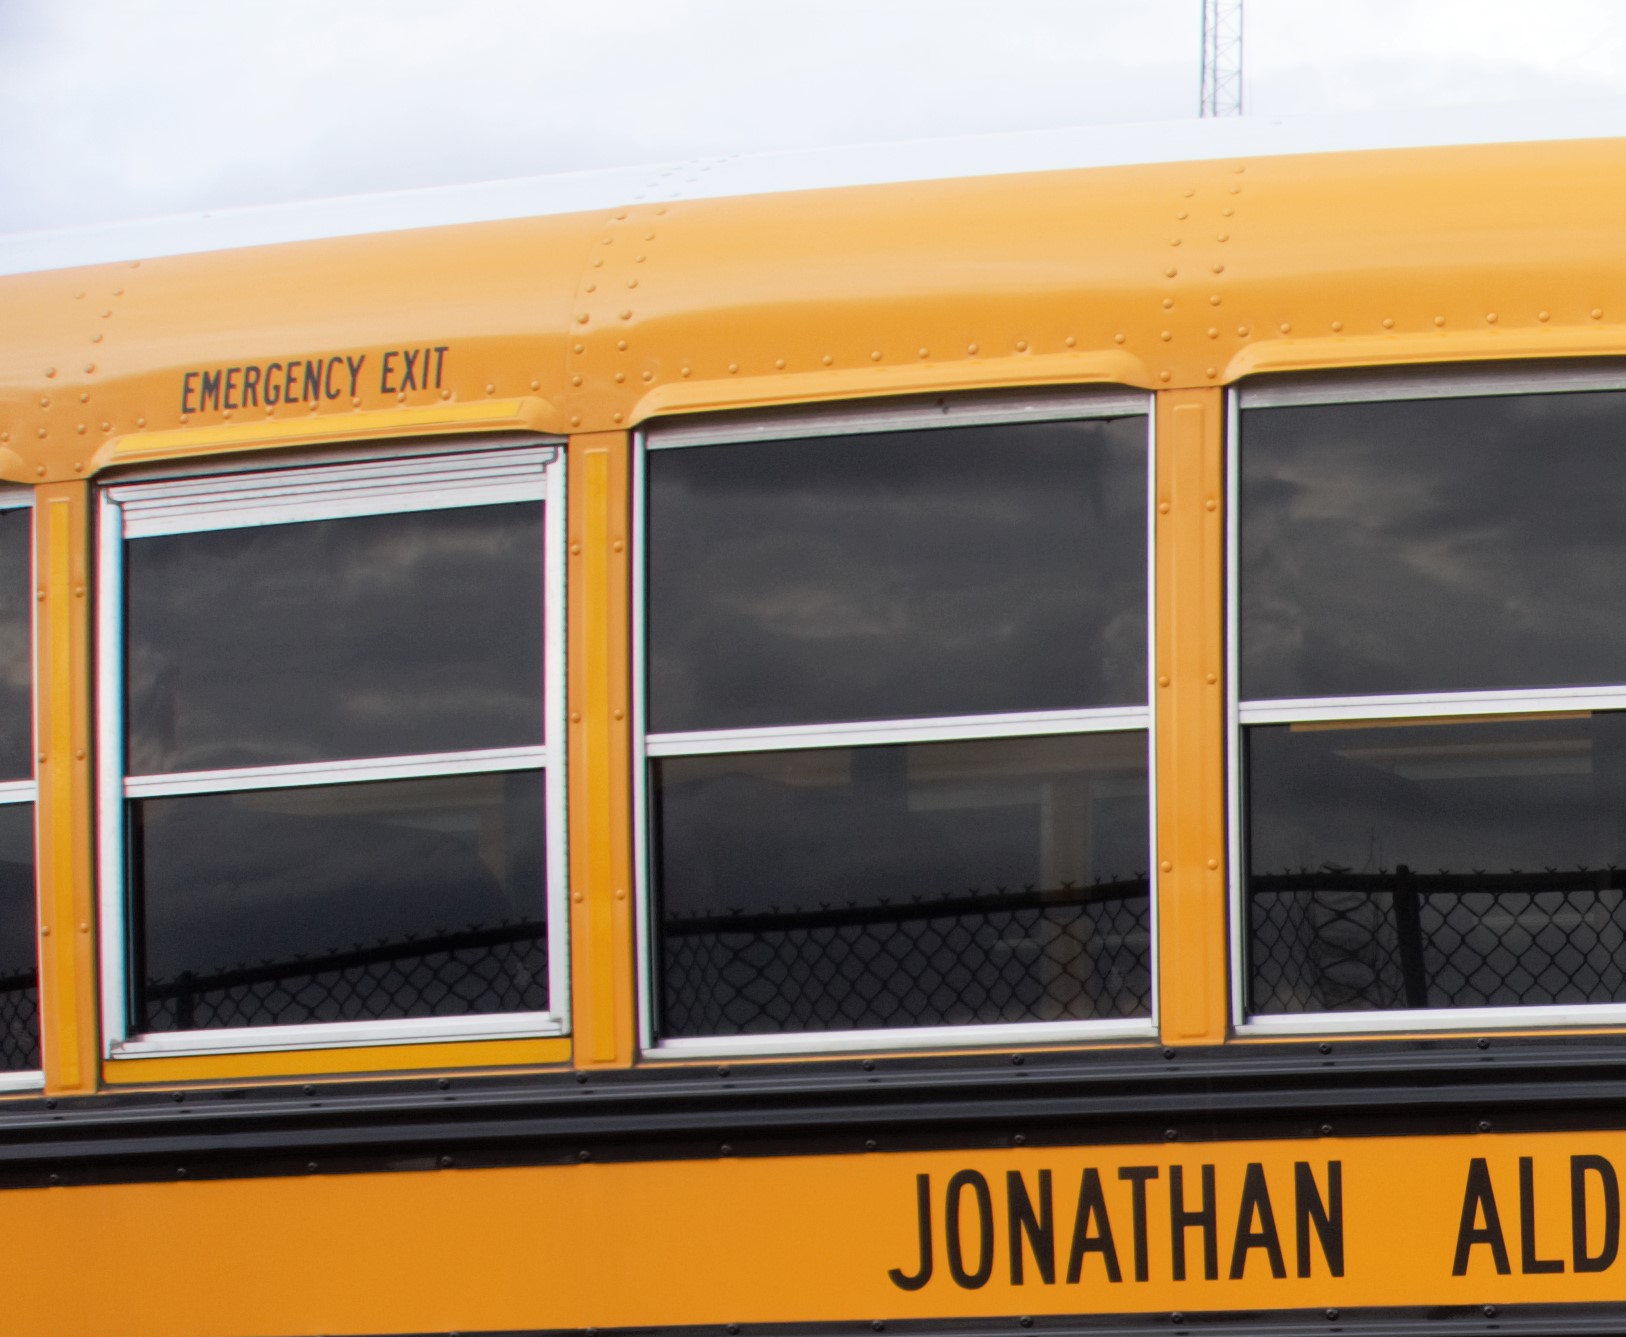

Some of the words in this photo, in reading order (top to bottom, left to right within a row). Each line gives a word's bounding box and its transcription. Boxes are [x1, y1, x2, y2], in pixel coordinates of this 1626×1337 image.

[180, 354, 365, 415] EMERGENCY
[379, 346, 449, 394] EXIT
[887, 1159, 1345, 1292] JONATHAN
